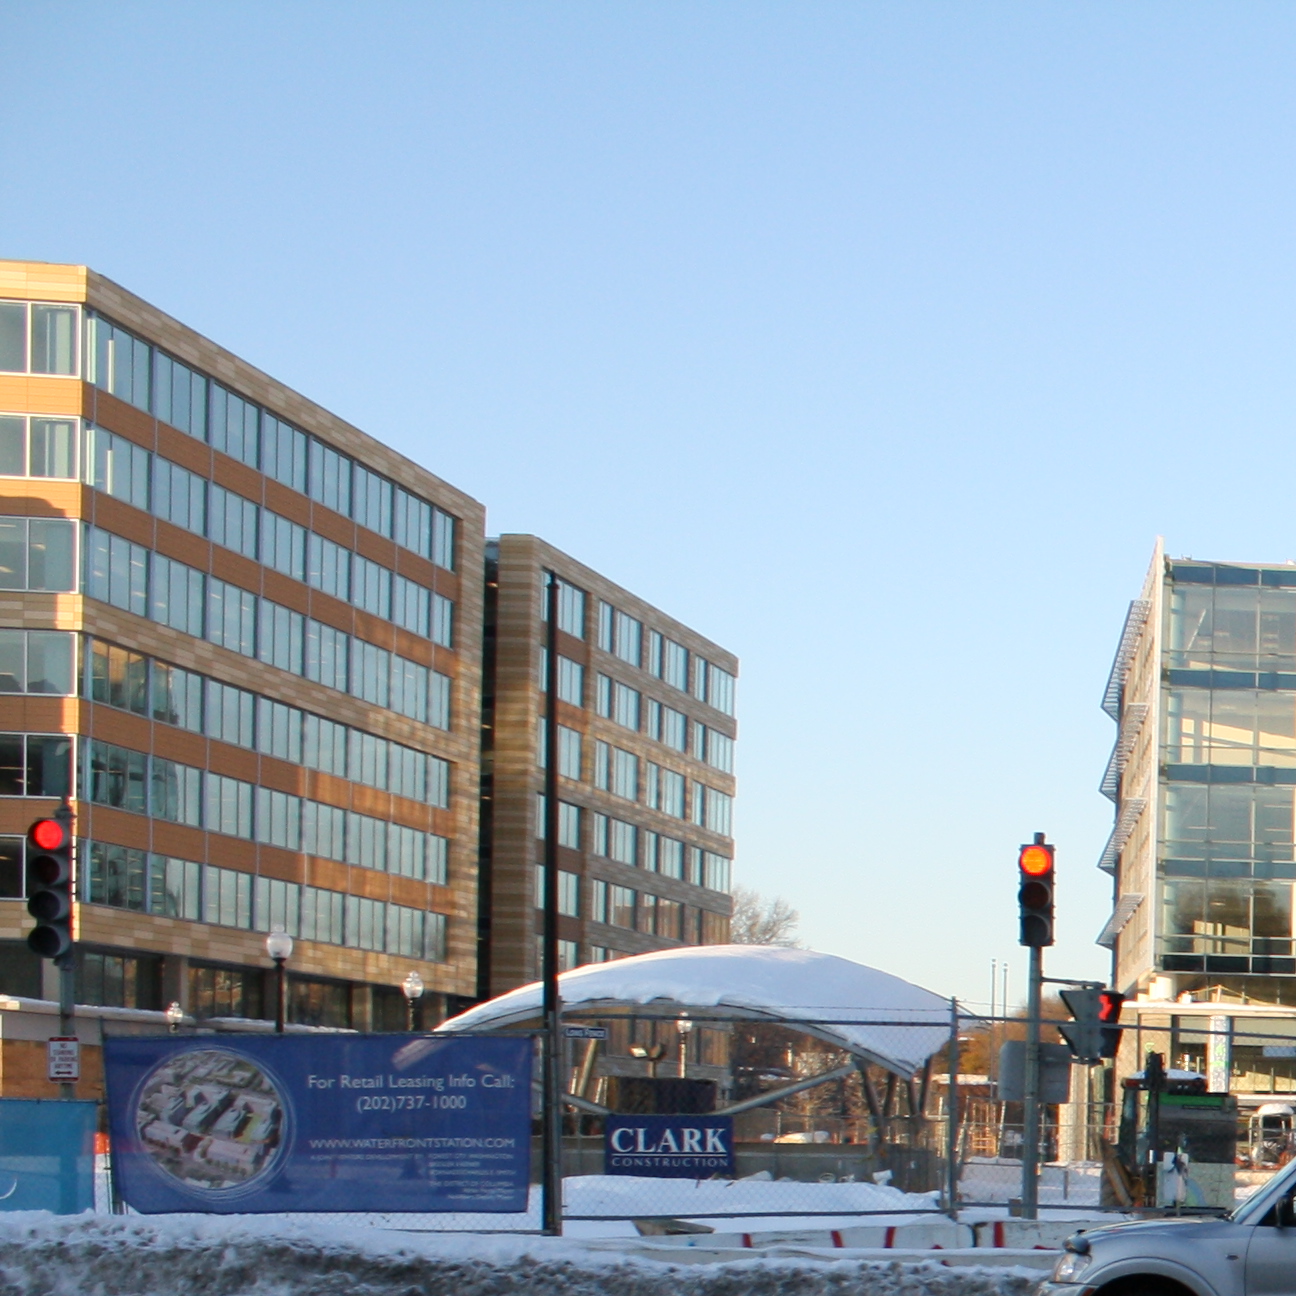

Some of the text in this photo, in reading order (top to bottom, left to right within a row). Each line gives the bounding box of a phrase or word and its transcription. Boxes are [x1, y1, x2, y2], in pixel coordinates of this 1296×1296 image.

[308, 1074, 515, 1091] For Retail Leasing Info Call:
[356, 1096, 467, 1113] (202)737-1000
[310, 1137, 515, 1149] WWW.WATERFRONTSTATION.COM
[611, 1127, 727, 1153] CLARK
[611, 1158, 728, 1167] CONSTRUCTION
